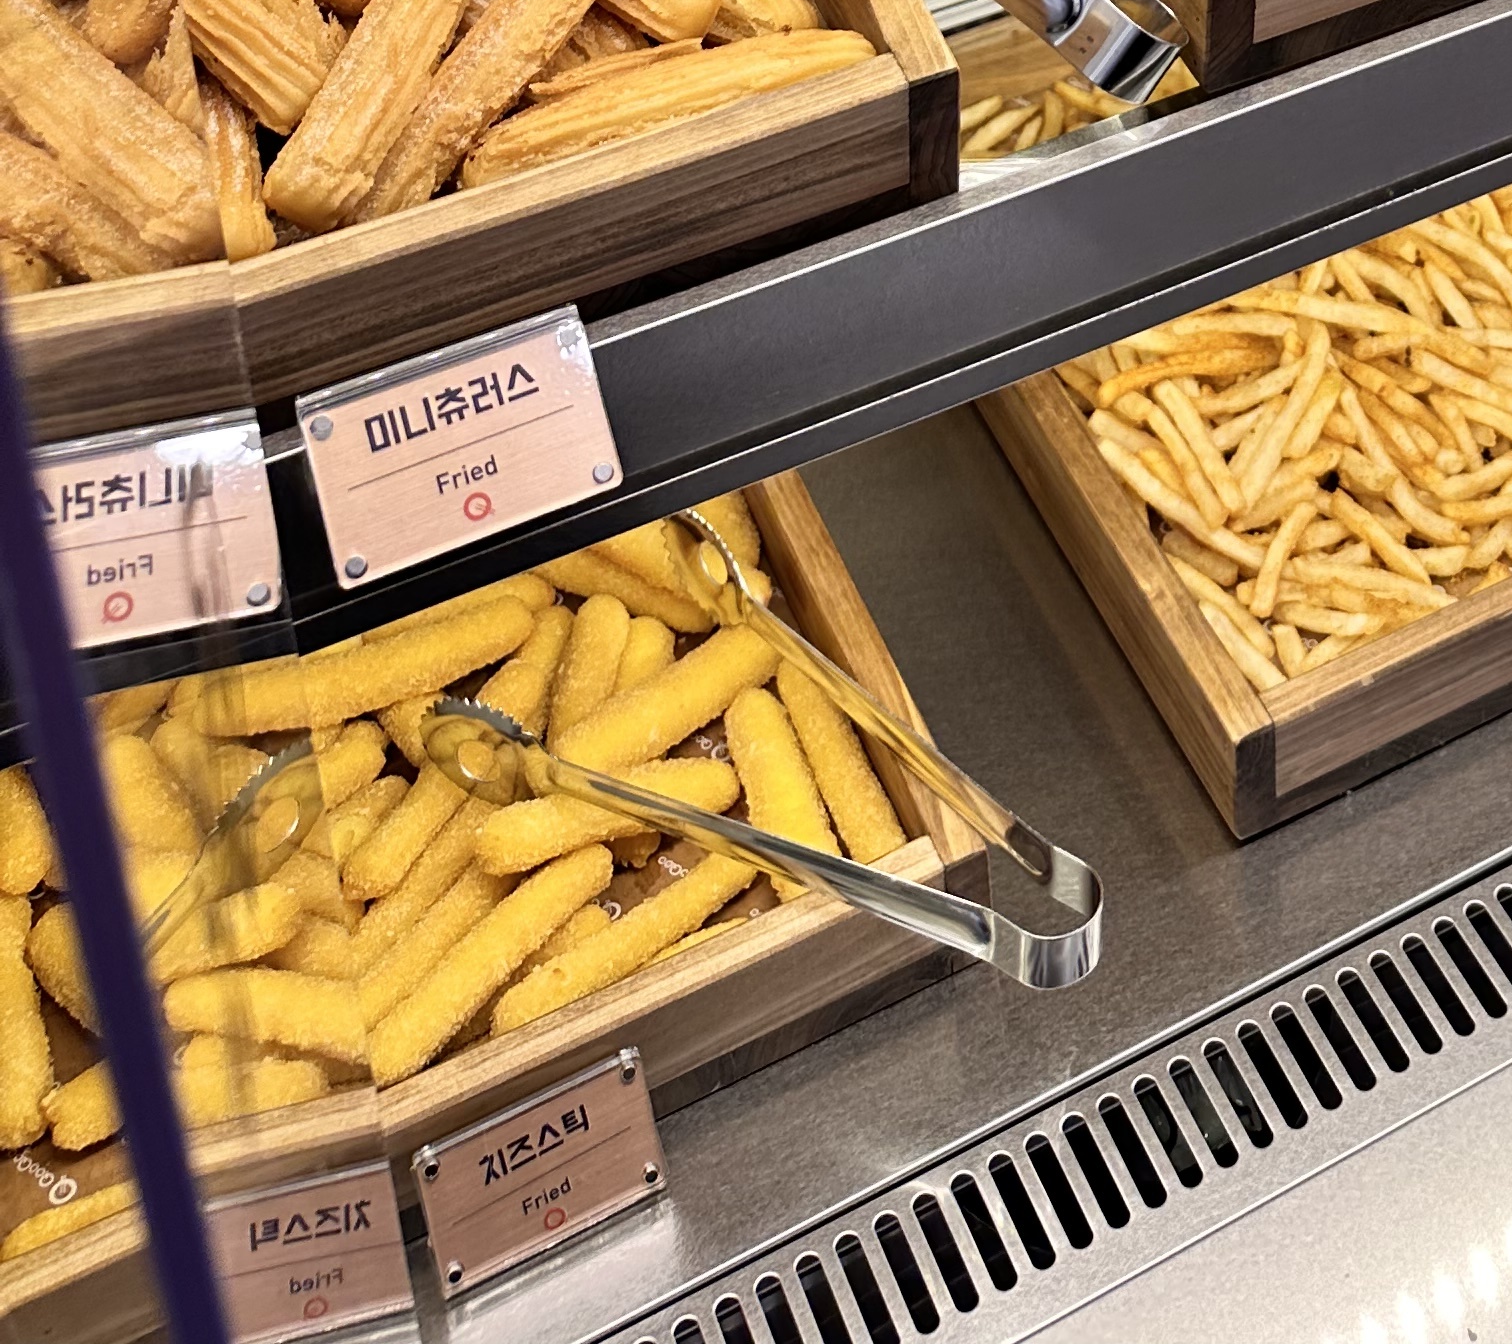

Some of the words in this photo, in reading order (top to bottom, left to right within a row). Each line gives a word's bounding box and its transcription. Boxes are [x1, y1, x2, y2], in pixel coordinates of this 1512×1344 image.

[363, 362, 540, 454] 미니츄러스
[435, 454, 499, 495] Fried
[478, 1103, 592, 1187] 치즈스틱
[520, 1176, 573, 1216] Fried
